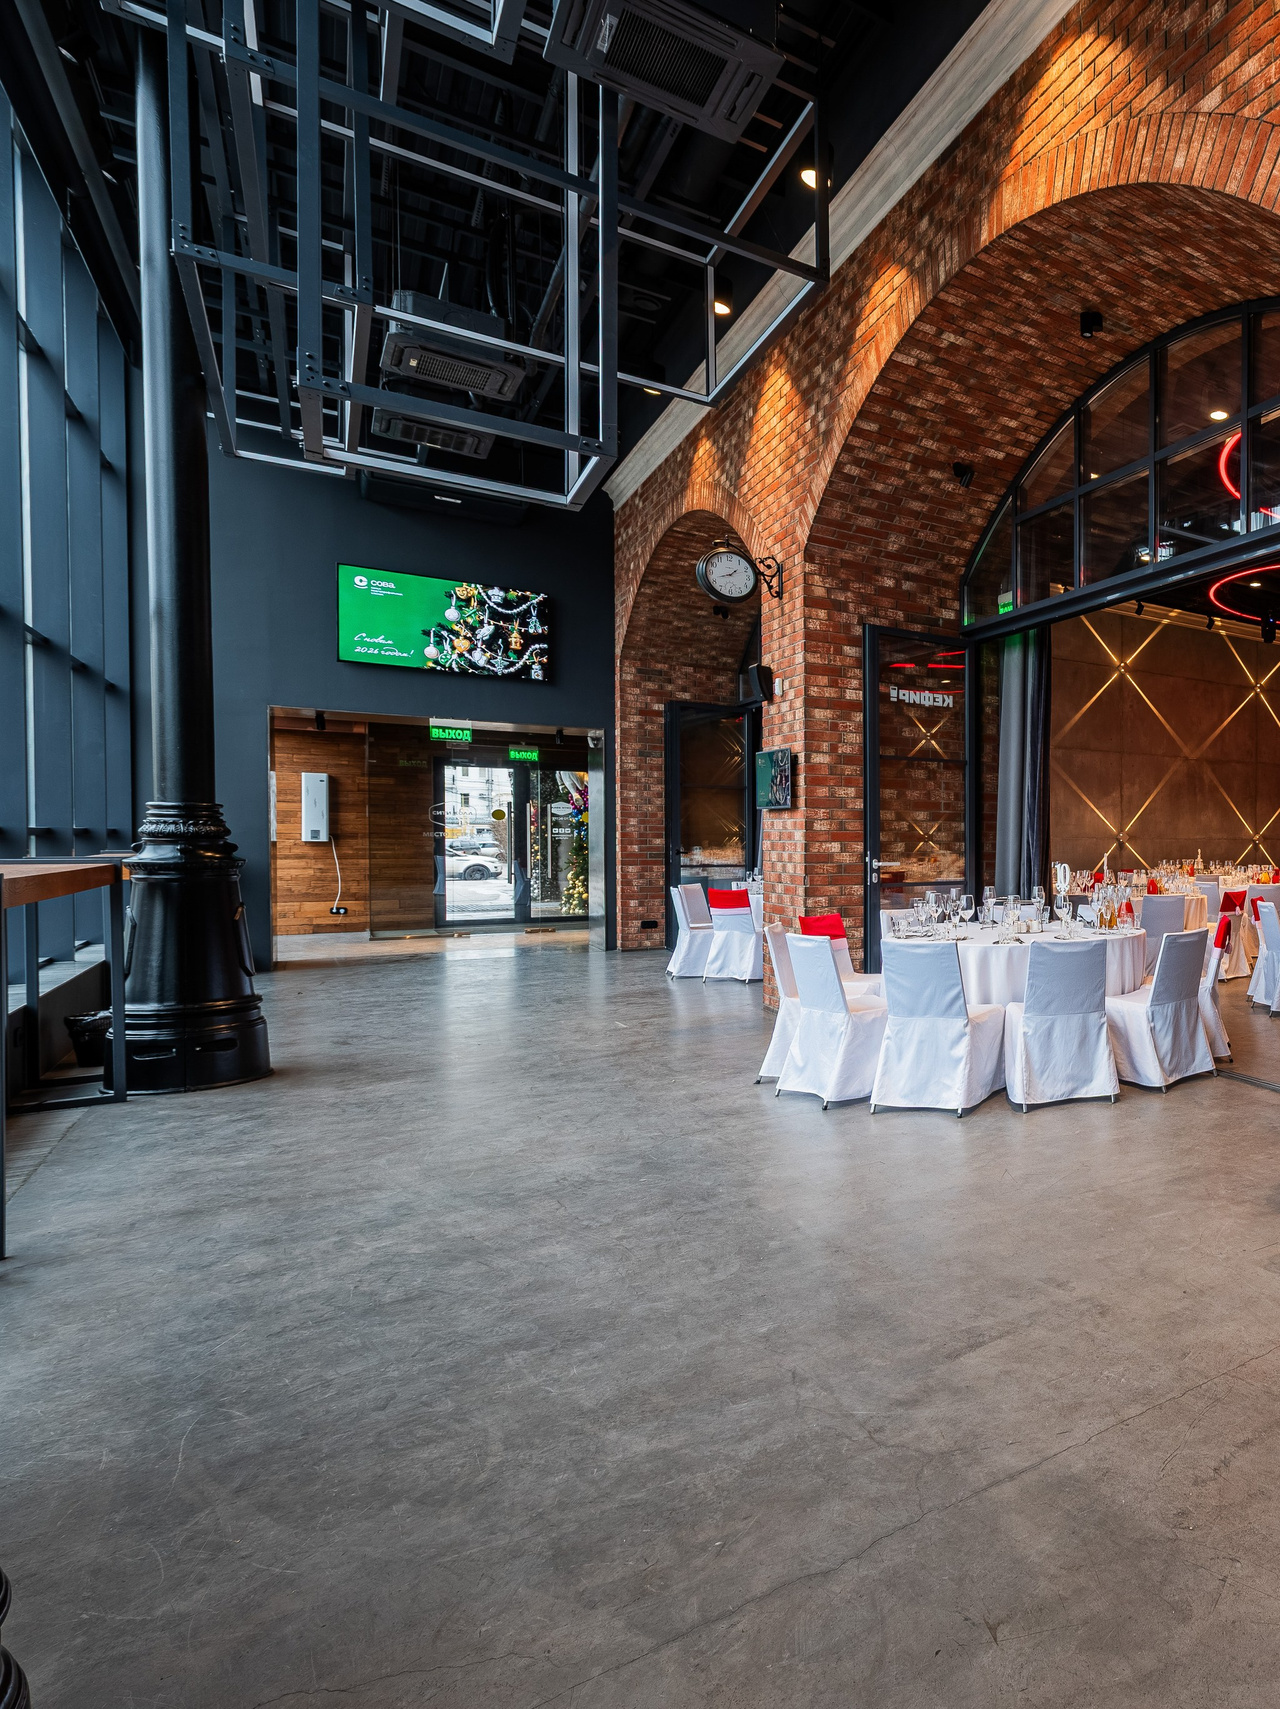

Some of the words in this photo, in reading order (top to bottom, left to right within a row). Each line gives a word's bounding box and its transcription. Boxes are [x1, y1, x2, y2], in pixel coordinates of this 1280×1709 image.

[354, 646, 379, 655] 2026
[431, 728, 471, 742] ВЫХОД
[510, 750, 538, 761] ВЫХОД
[1056, 863, 1071, 886] 10
